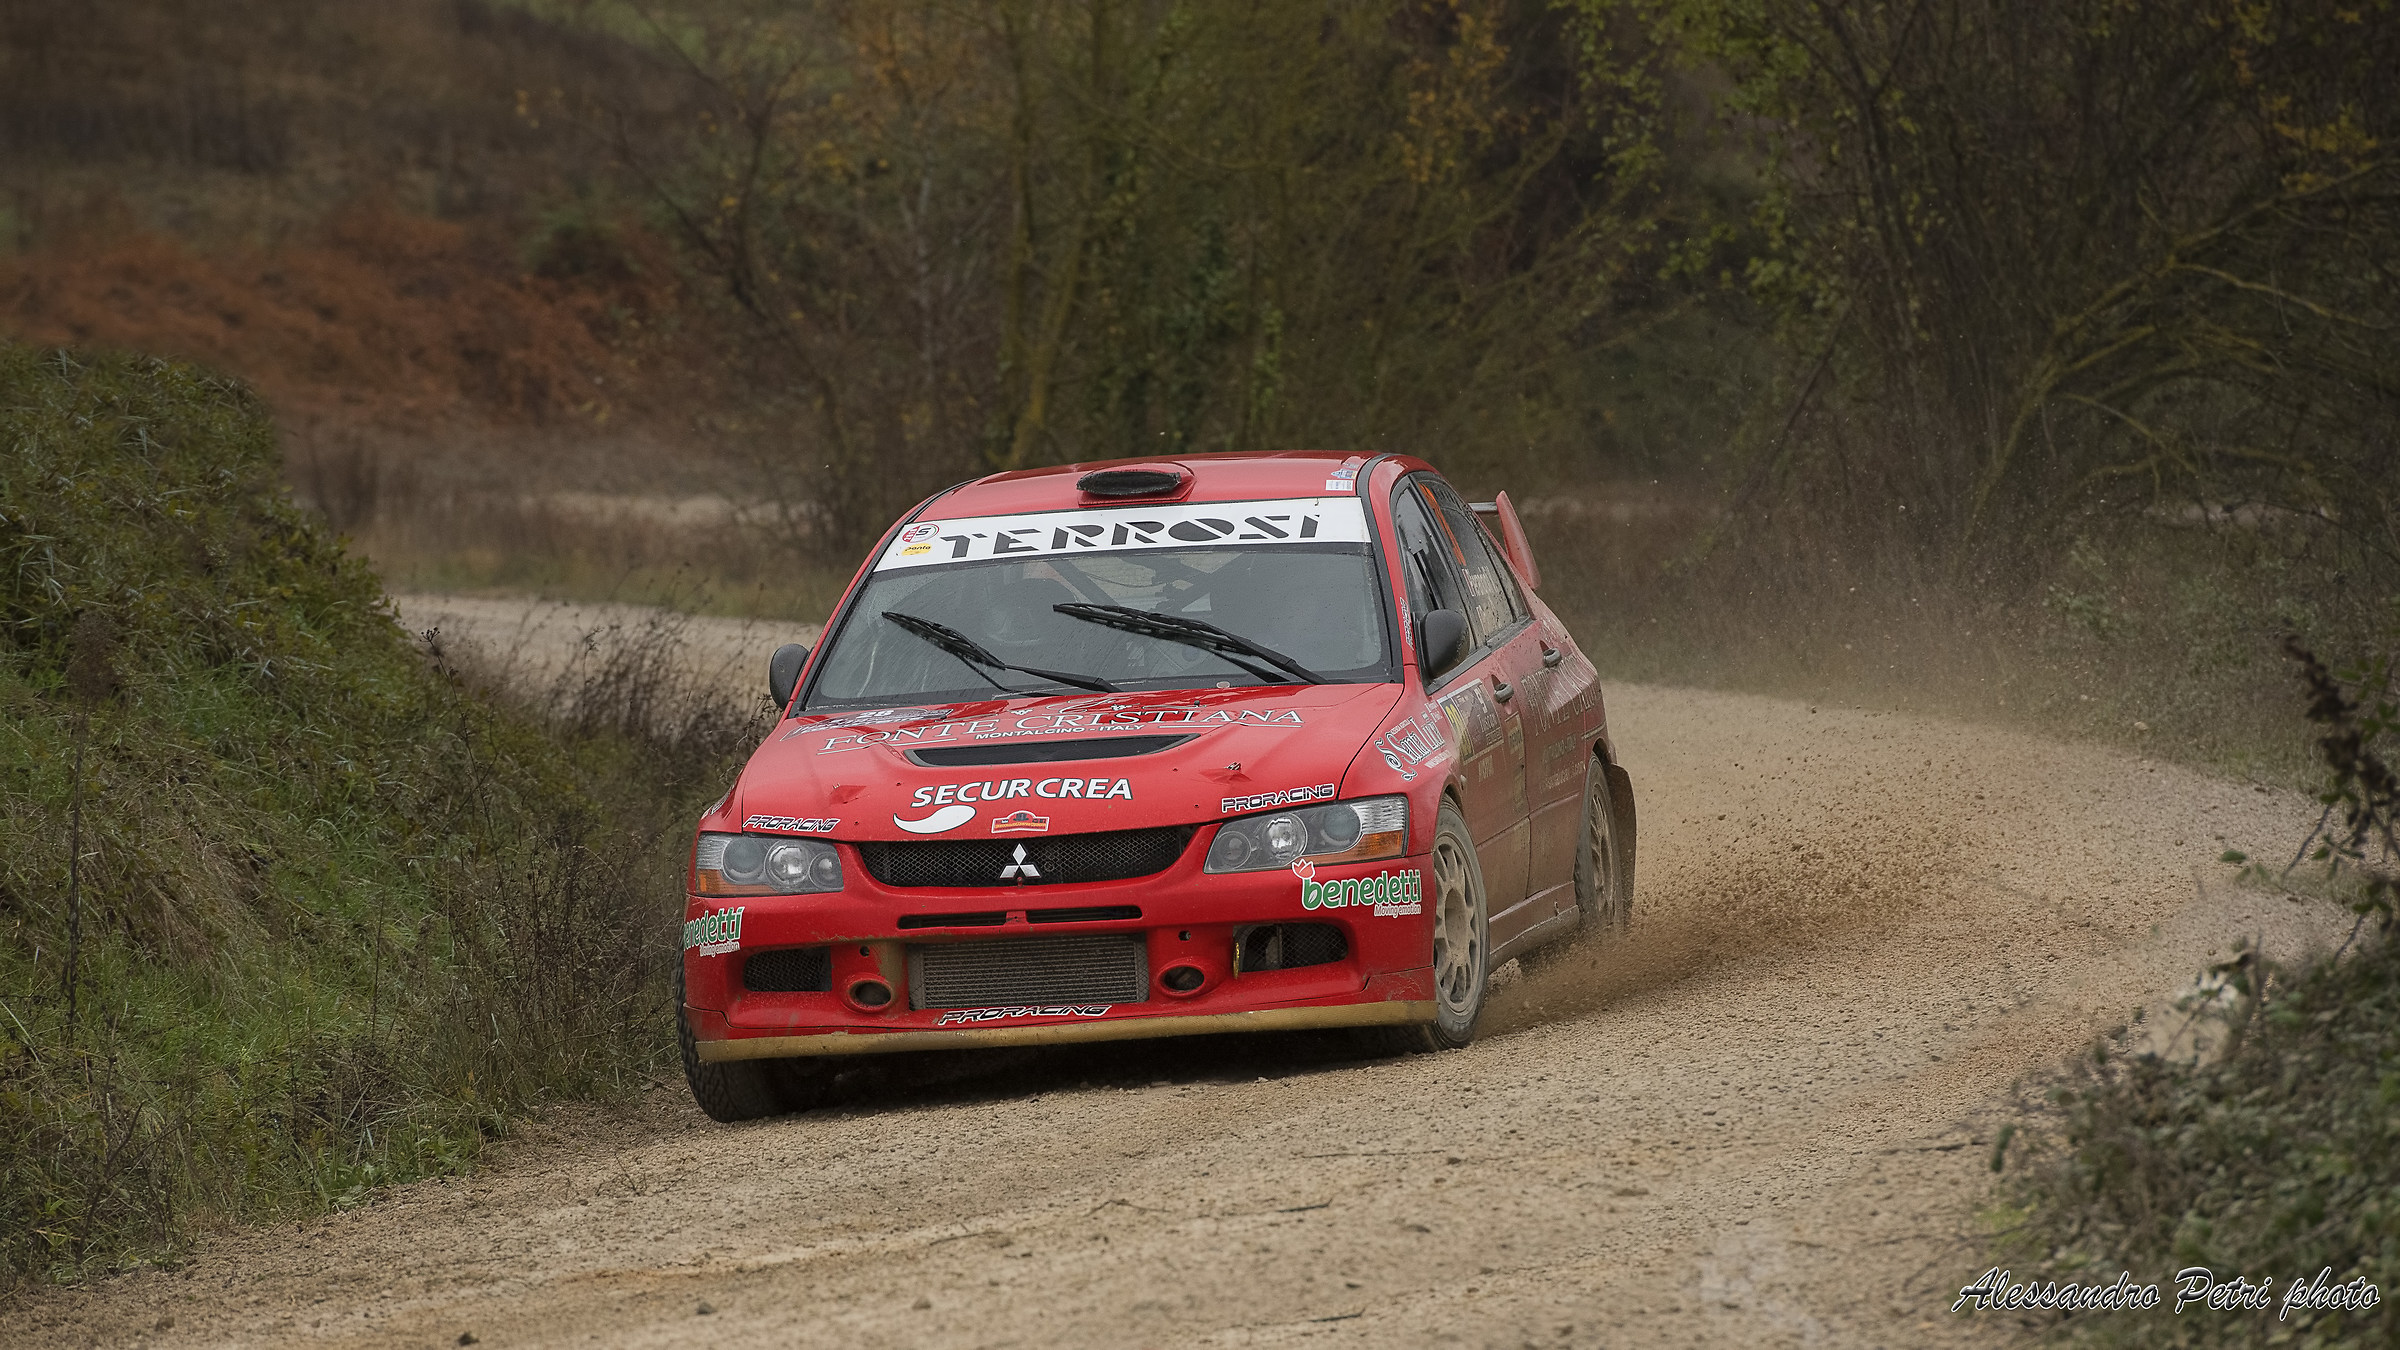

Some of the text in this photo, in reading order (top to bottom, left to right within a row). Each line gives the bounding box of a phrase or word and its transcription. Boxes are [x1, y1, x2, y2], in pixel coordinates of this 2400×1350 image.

[818, 718, 1001, 751] FONTE
[1016, 709, 1305, 730] CRISTIANA
[975, 727, 1085, 740] MONTALCINO
[1099, 724, 1145, 732] ITALY
[1221, 783, 1335, 813] PRORACING
[743, 815, 840, 832] PRORACING
[1301, 868, 1422, 911] benedetti
[683, 906, 745, 951] enedetti
[938, 1005, 1112, 1026] PRORACING
